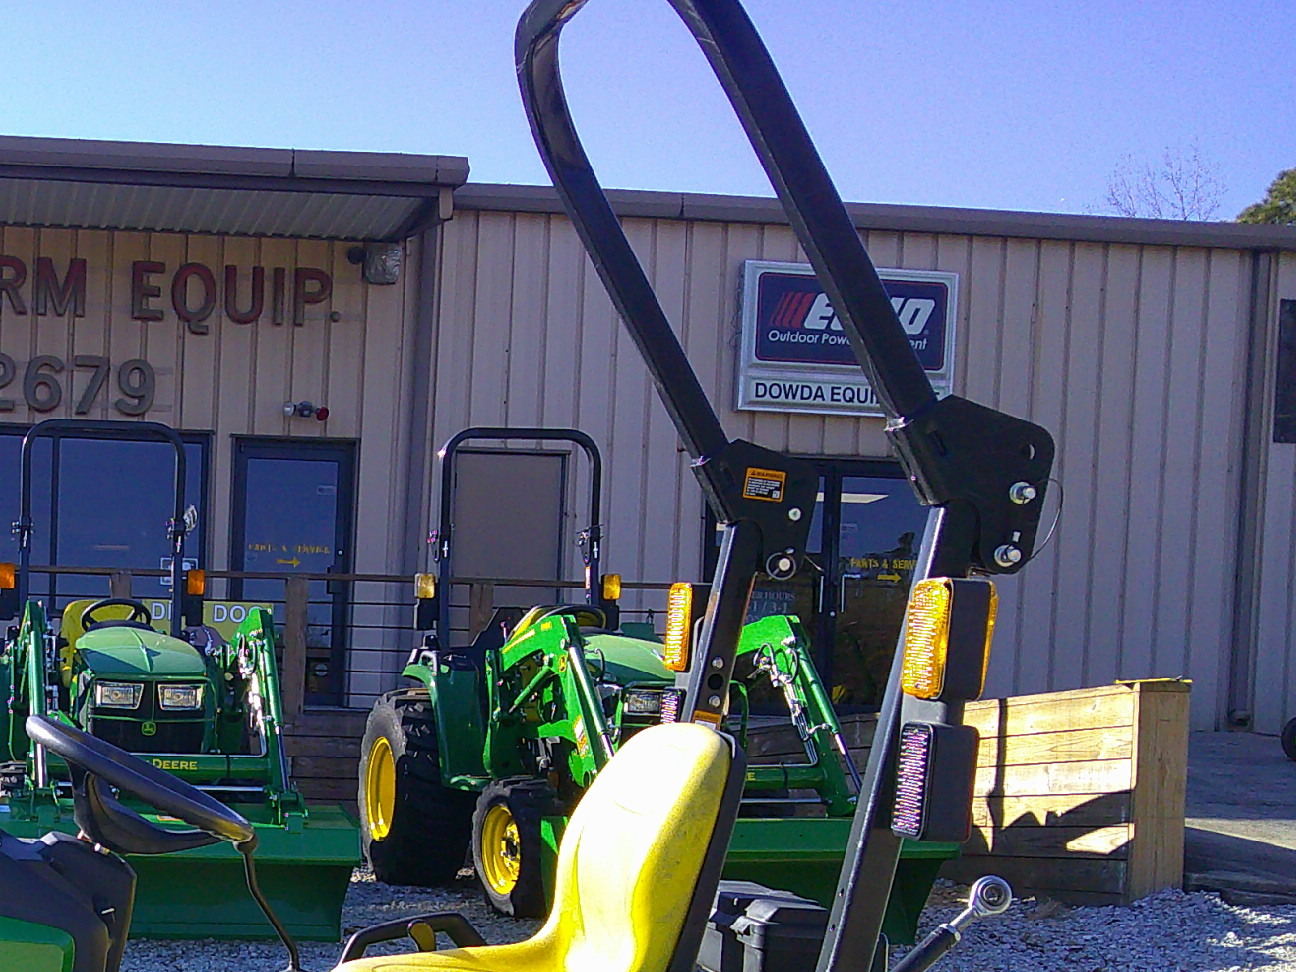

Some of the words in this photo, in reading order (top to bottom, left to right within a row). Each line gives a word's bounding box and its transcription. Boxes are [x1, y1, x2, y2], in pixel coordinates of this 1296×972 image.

[131, 261, 341, 335] EQUIP.
[804, 292, 936, 335] EO
[768, 330, 819, 344] Outdoor
[821, 333, 851, 345] Pow
[755, 382, 825, 401] DOWDA
[892, 560, 916, 570] SERV
[152, 758, 198, 770] DEERE
